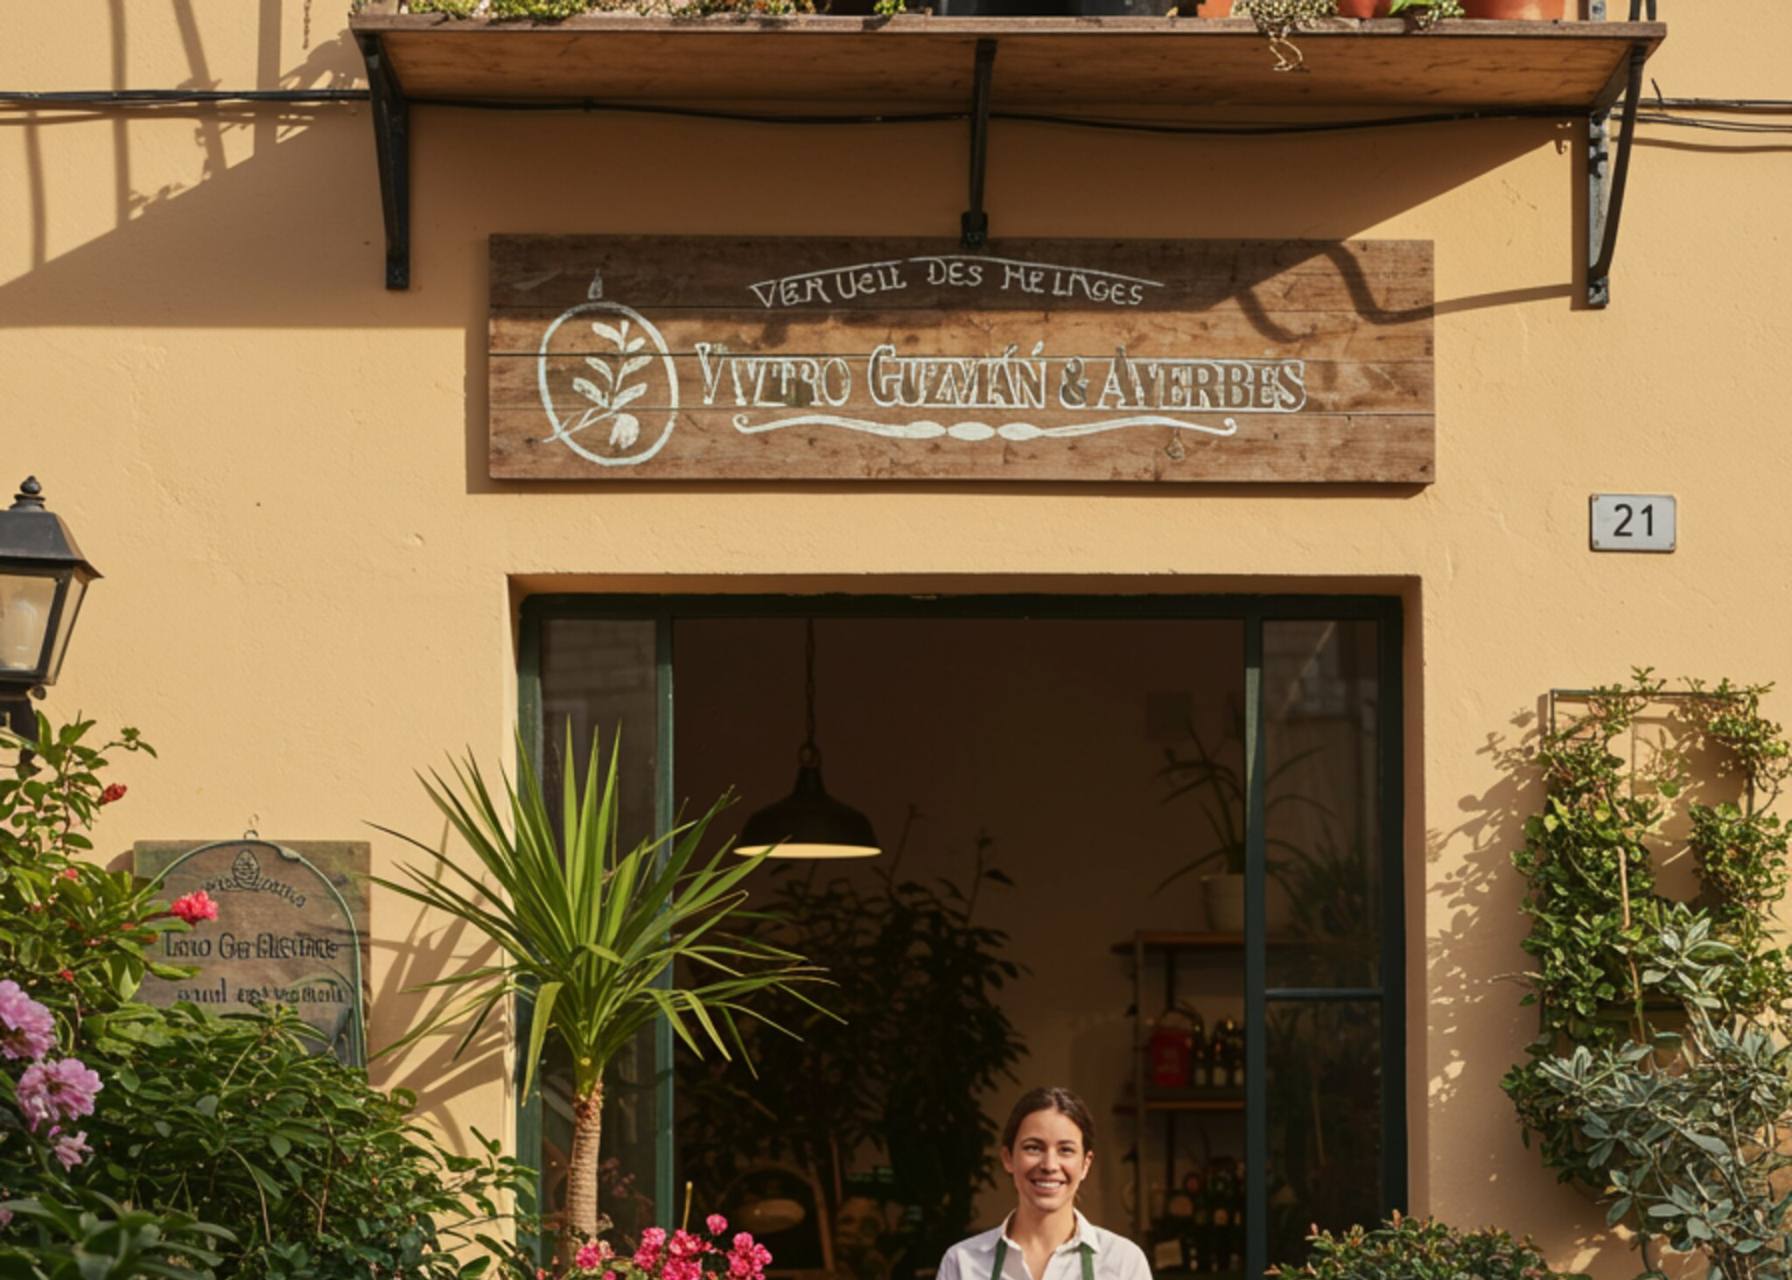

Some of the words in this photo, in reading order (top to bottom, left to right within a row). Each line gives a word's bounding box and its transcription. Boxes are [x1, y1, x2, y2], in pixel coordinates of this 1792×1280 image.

[927, 258, 983, 287] DES
[1059, 356, 1089, 409] &
[1613, 503, 1653, 537] 21
